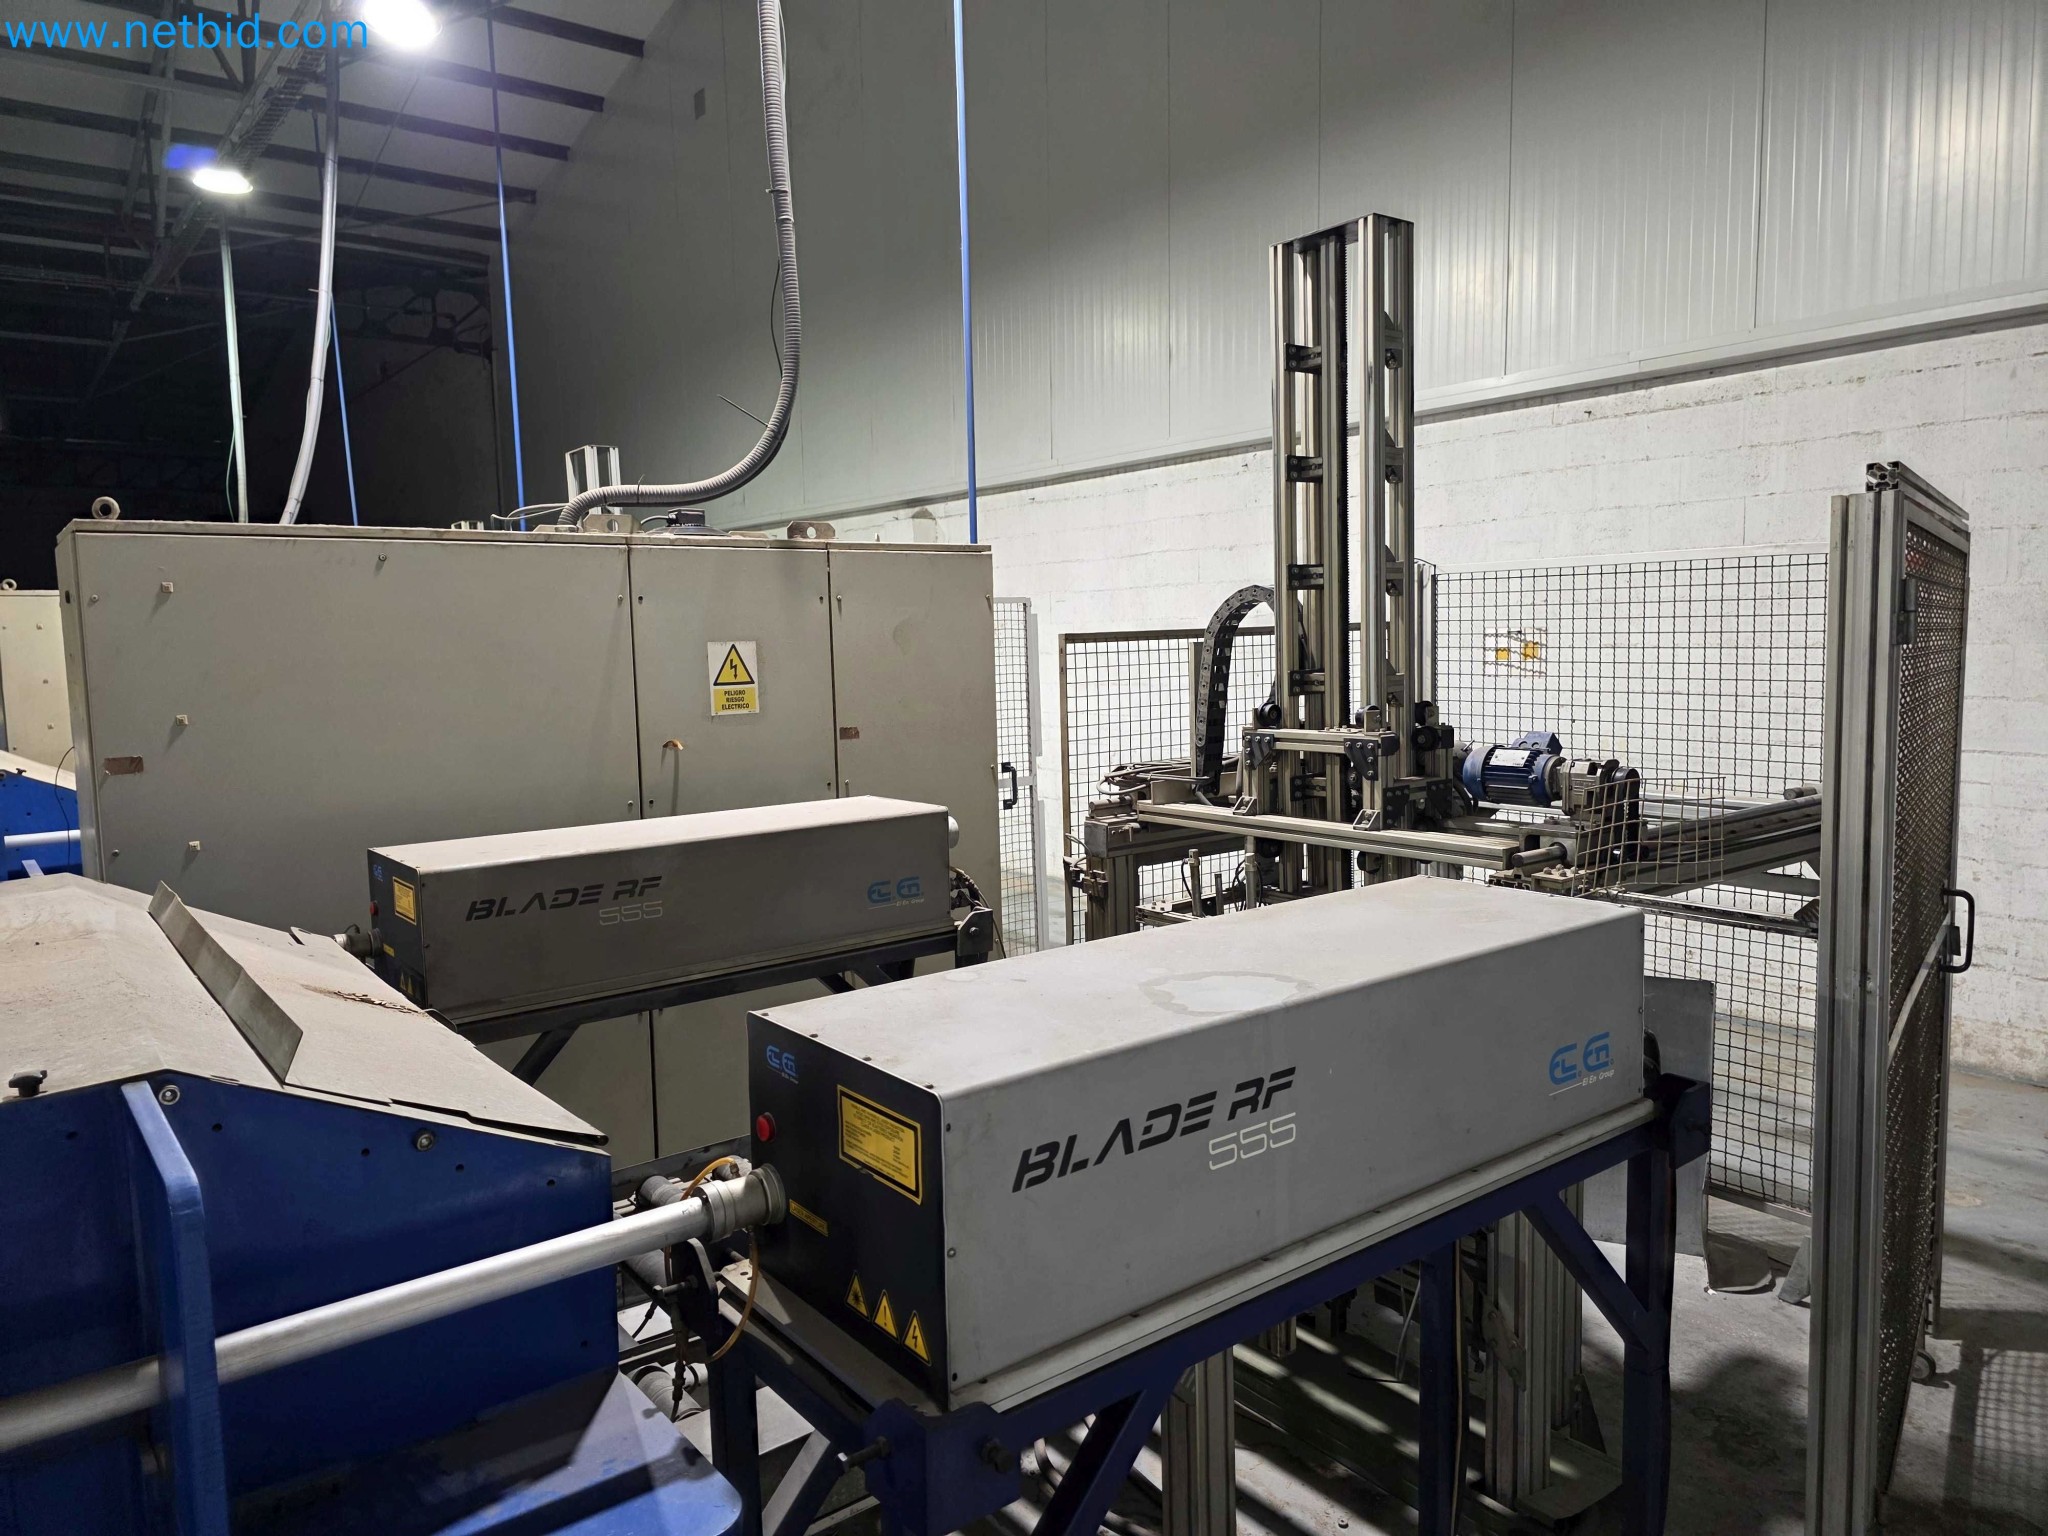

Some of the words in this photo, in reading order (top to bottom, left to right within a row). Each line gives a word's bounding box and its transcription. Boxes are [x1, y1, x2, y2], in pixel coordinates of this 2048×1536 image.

[465, 883, 604, 922] BLADE
[612, 875, 663, 901] RF
[599, 900, 664, 926] 555
[1012, 1090, 1218, 1193] BLADE
[1227, 1066, 1297, 1122] RF
[1209, 1112, 1297, 1171] 555
